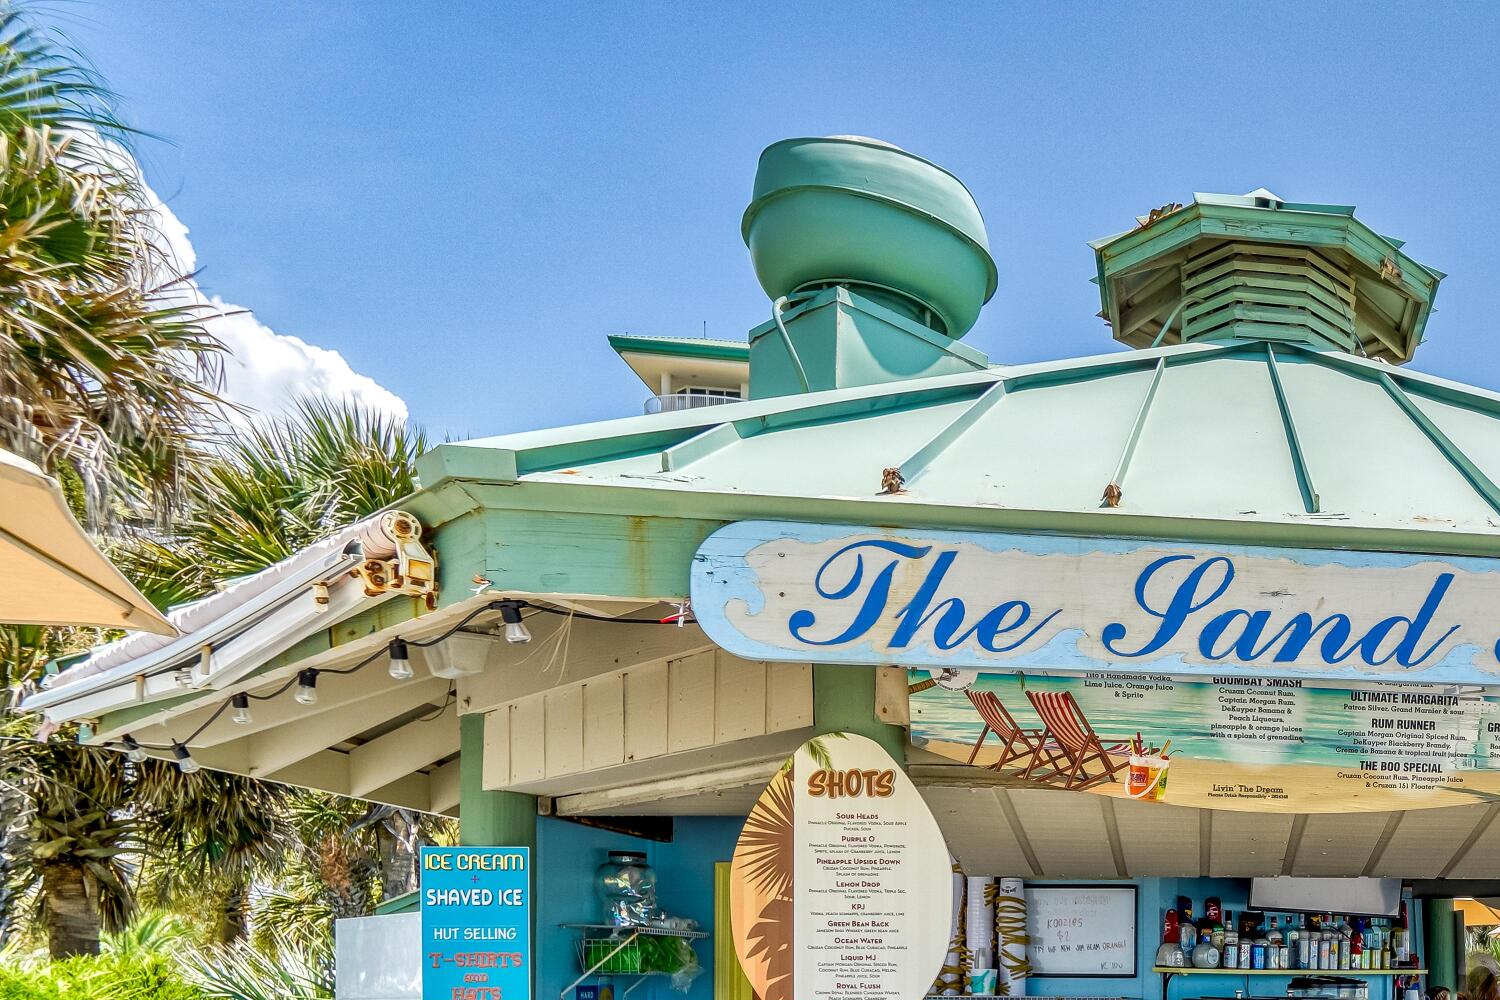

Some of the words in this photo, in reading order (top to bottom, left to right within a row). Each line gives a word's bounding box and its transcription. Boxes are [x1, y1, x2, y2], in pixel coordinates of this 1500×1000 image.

[788, 539, 1063, 653] The
[1102, 554, 1461, 669] Sand
[1126, 682, 1154, 690] Orange
[1267, 679, 1302, 687] SMASH
[1122, 691, 1143, 699] Sprite
[1219, 696, 1247, 704] Captain
[1350, 692, 1398, 703] ULTIMATE
[1401, 694, 1459, 706] MARGARITA
[1222, 705, 1257, 713] DeKuyper
[1372, 718, 1393, 729] RUM
[1397, 720, 1436, 730] RUNNER
[1360, 761, 1377, 770] THE
[1381, 762, 1400, 771] BOO
[1403, 762, 1442, 773] SPECIAL
[807, 768, 896, 799] SHOTS
[425, 854, 453, 870] ICE
[457, 854, 525, 871] CREAM
[427, 889, 493, 906] SHAVED
[498, 889, 523, 906] ICE
[434, 928, 460, 940] HUT
[464, 928, 517, 940] SELLING
[429, 952, 522, 968] T-SHIRTS
